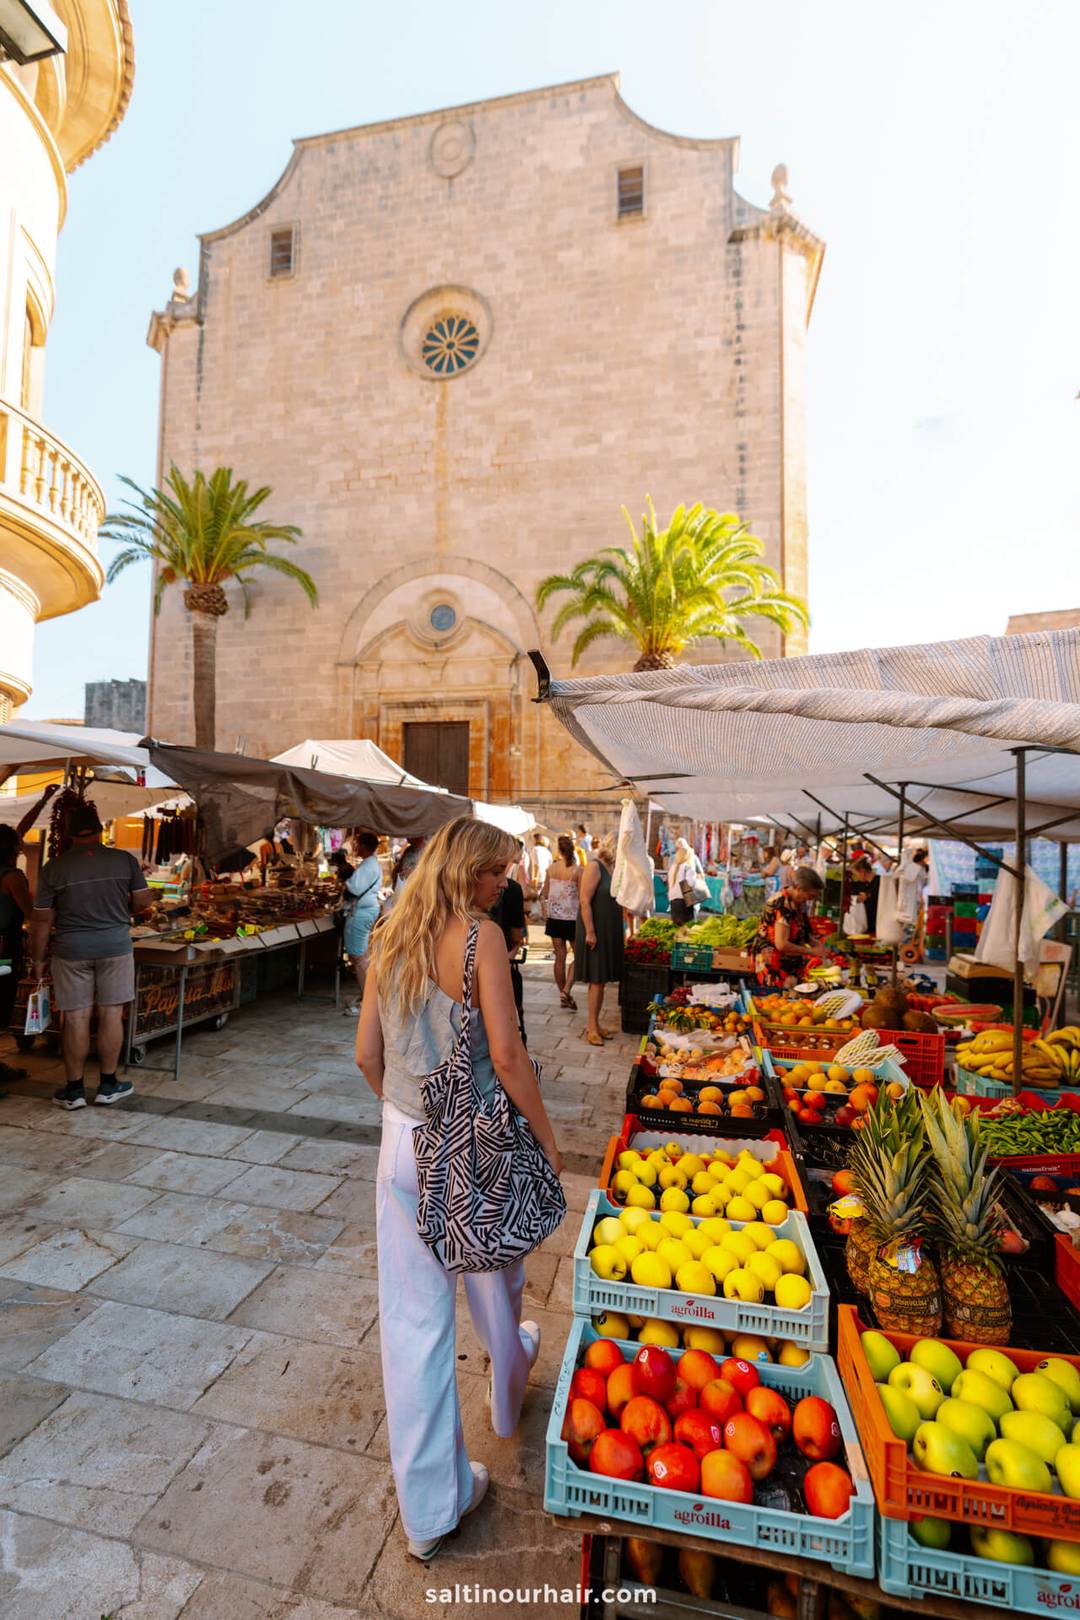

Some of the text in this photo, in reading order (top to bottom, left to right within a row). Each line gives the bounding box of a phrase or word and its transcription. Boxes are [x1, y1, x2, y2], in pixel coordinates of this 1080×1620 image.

[143, 984, 203, 1018] Paysa
[671, 1305, 715, 1320] agroilla
[674, 1510, 730, 1529] agroilla
